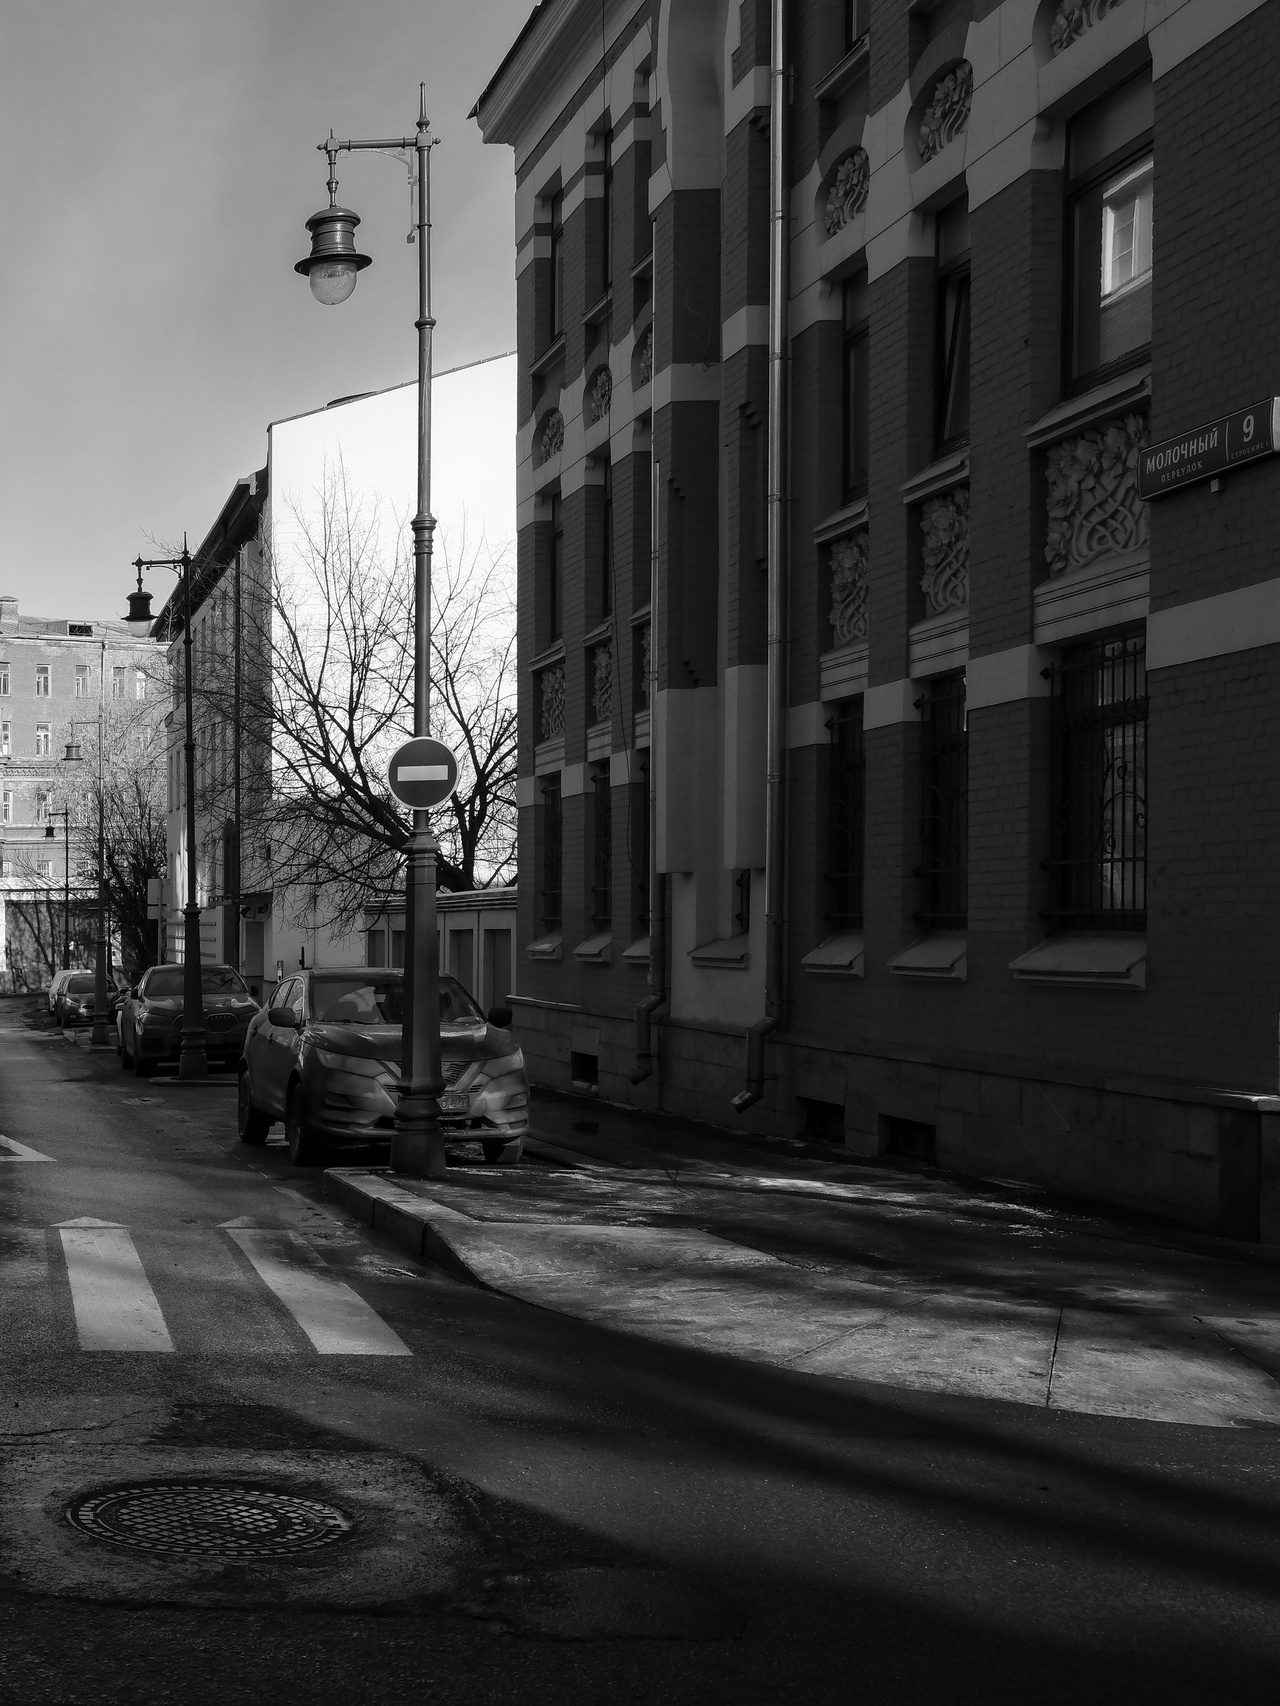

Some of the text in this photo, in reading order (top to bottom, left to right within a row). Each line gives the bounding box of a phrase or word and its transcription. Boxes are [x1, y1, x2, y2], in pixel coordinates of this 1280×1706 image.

[1242, 414, 1255, 442] 9
[1146, 427, 1219, 474] МОЛОЧНЫЙ
[1230, 441, 1264, 460] СТРОЕНИЕ
[1161, 460, 1203, 484] ПЕРЕУЛОК
